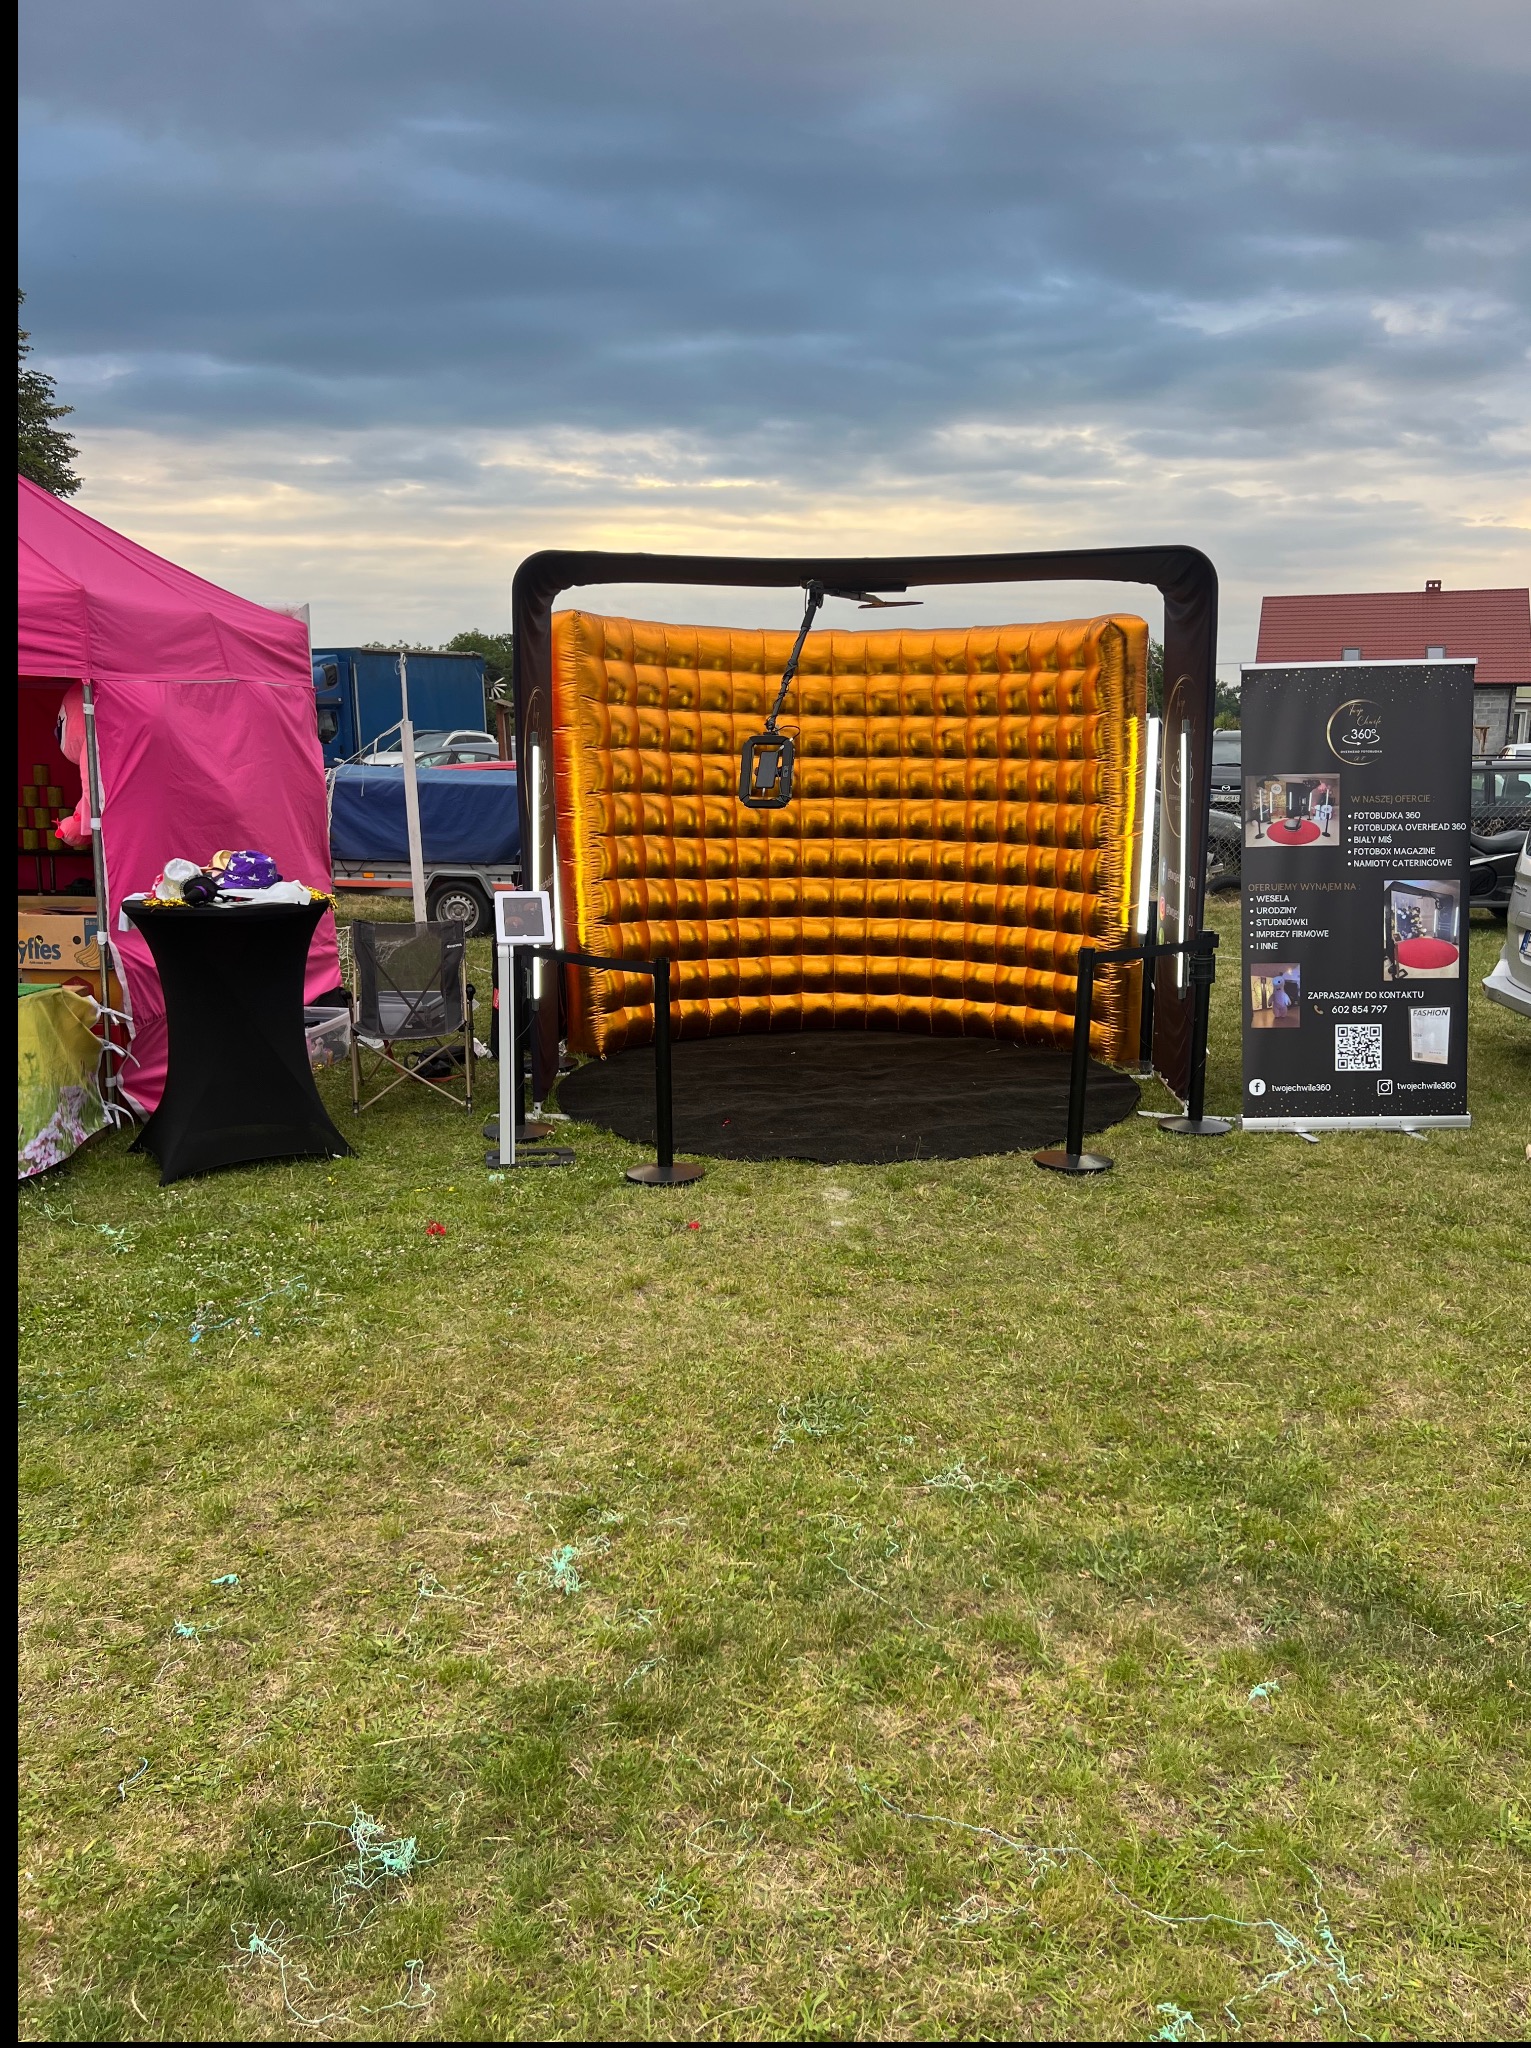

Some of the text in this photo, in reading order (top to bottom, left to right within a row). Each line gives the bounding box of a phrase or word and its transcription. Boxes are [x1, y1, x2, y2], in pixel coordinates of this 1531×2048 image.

[1351, 795, 1359, 803] W
[1362, 795, 1393, 804] NASZEJ
[1395, 795, 1430, 803] OFERCIE
[1405, 811, 1420, 819] 360
[1405, 823, 1450, 831] OVERHEAD
[1378, 834, 1392, 843] MIŚ
[1394, 847, 1435, 855] MAGAZINE
[1392, 859, 1452, 867] CATERINGOWE
[1248, 883, 1297, 892] OFERUJEMY
[1300, 883, 1341, 892] WYNAJEM
[1256, 917, 1308, 926] STUDNIÓWKI
[1256, 930, 1290, 938] IMPREZY
[1260, 942, 1278, 950] INNE
[1307, 991, 1424, 1000] ZAPRASZAMY DO KONTAKTU
[1332, 1005, 1388, 1014] 602 854 797
[1271, 1084, 1331, 1093] twojechwile360
[1396, 1082, 1456, 1092] twojechwile360
